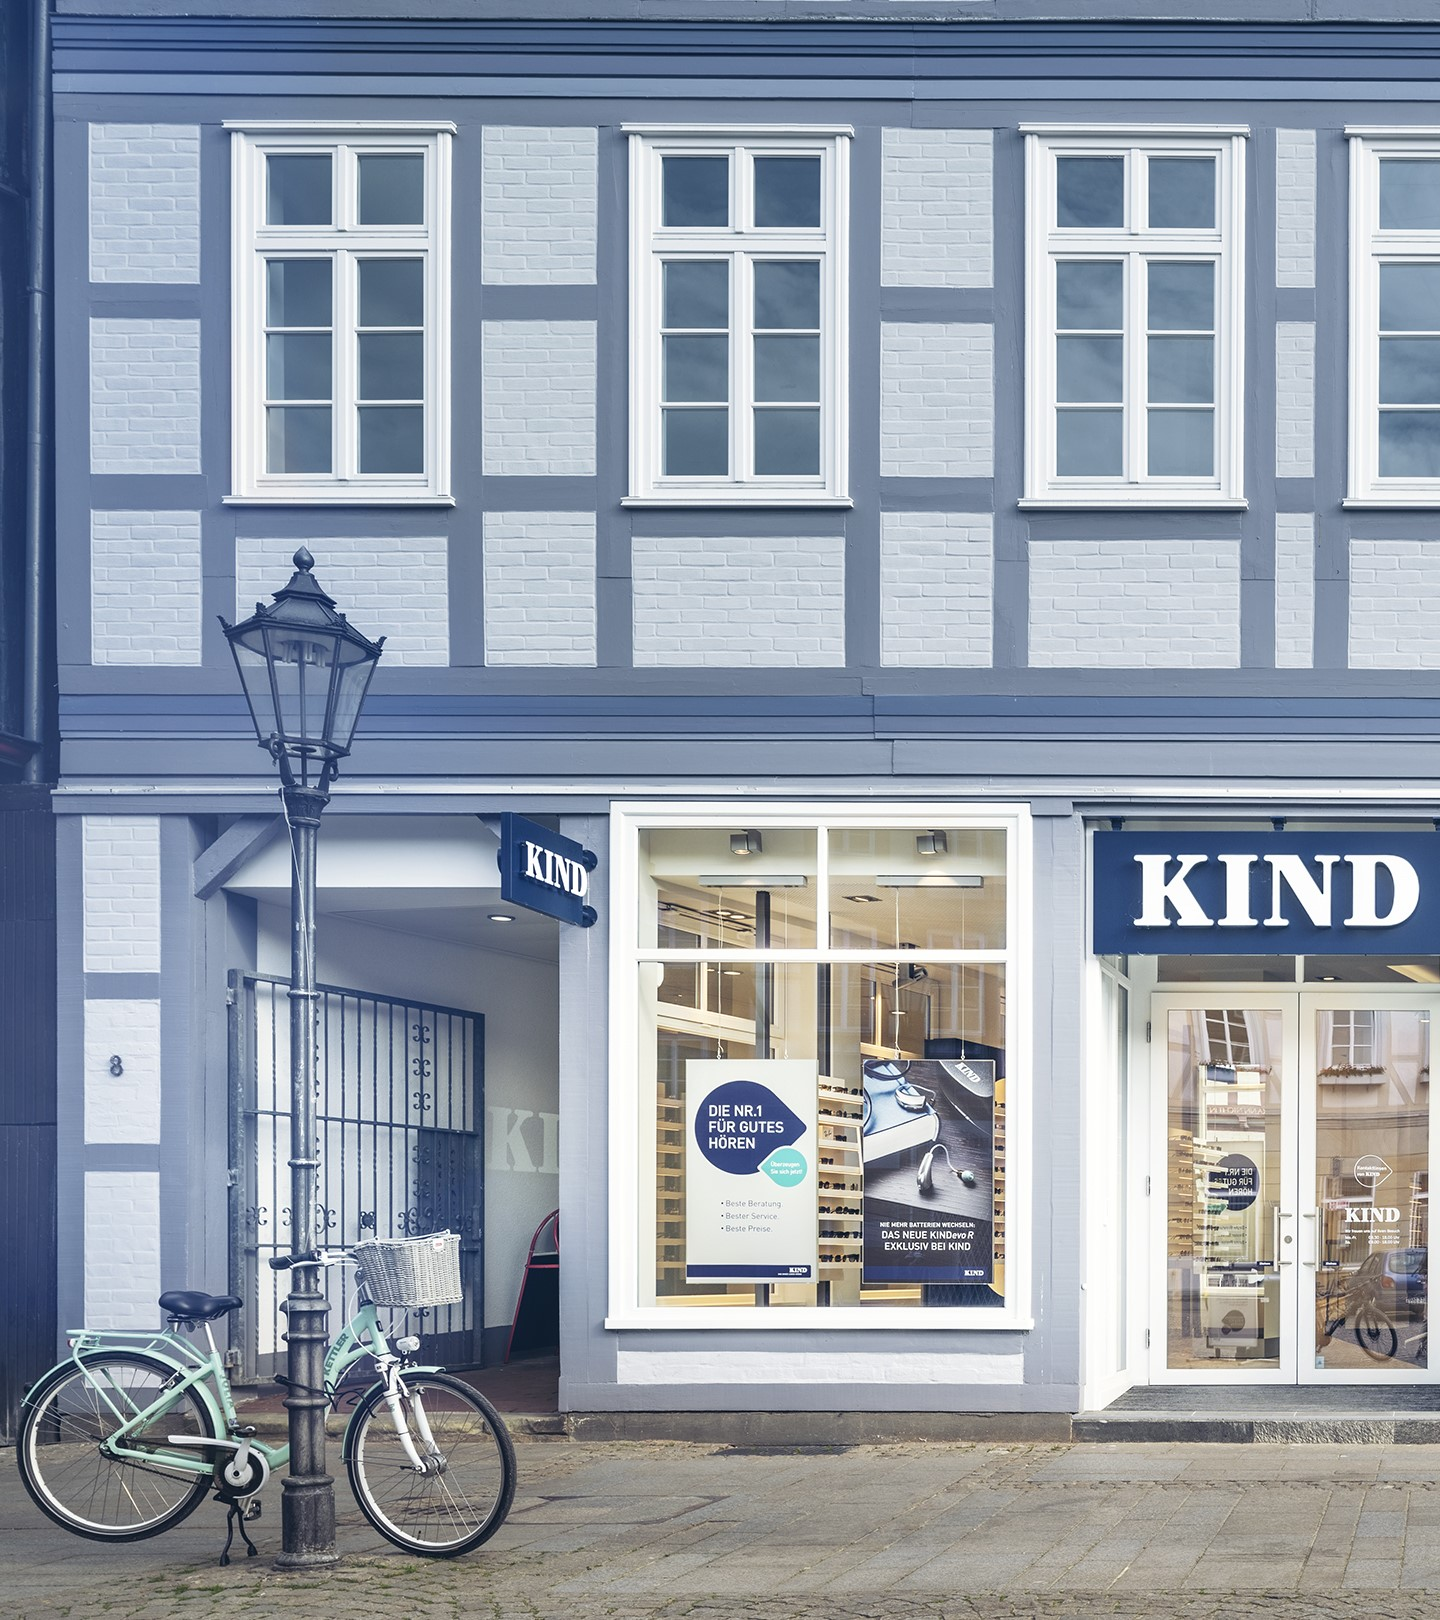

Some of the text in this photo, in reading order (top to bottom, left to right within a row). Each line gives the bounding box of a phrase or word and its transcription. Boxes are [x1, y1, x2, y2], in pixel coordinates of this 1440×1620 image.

[525, 841, 588, 897] KIND
[1133, 854, 1420, 927] KIND
[109, 1055, 124, 1077] 8
[708, 1104, 763, 1117] DIE NR.1
[708, 1118, 785, 1134] FÜR GUTES
[708, 1134, 756, 1150] HÖREN
[725, 1200, 747, 1208] Beste
[725, 1212, 750, 1220] Bester
[1344, 1207, 1401, 1223] KIND
[725, 1225, 747, 1233] Beste
[881, 1230, 900, 1240] DAS
[902, 1230, 928, 1240] NEUE
[884, 1242, 971, 1251] EXKLUSIV BEI KIND
[964, 1269, 985, 1277] KIND
[323, 1332, 349, 1377] KETTLER
